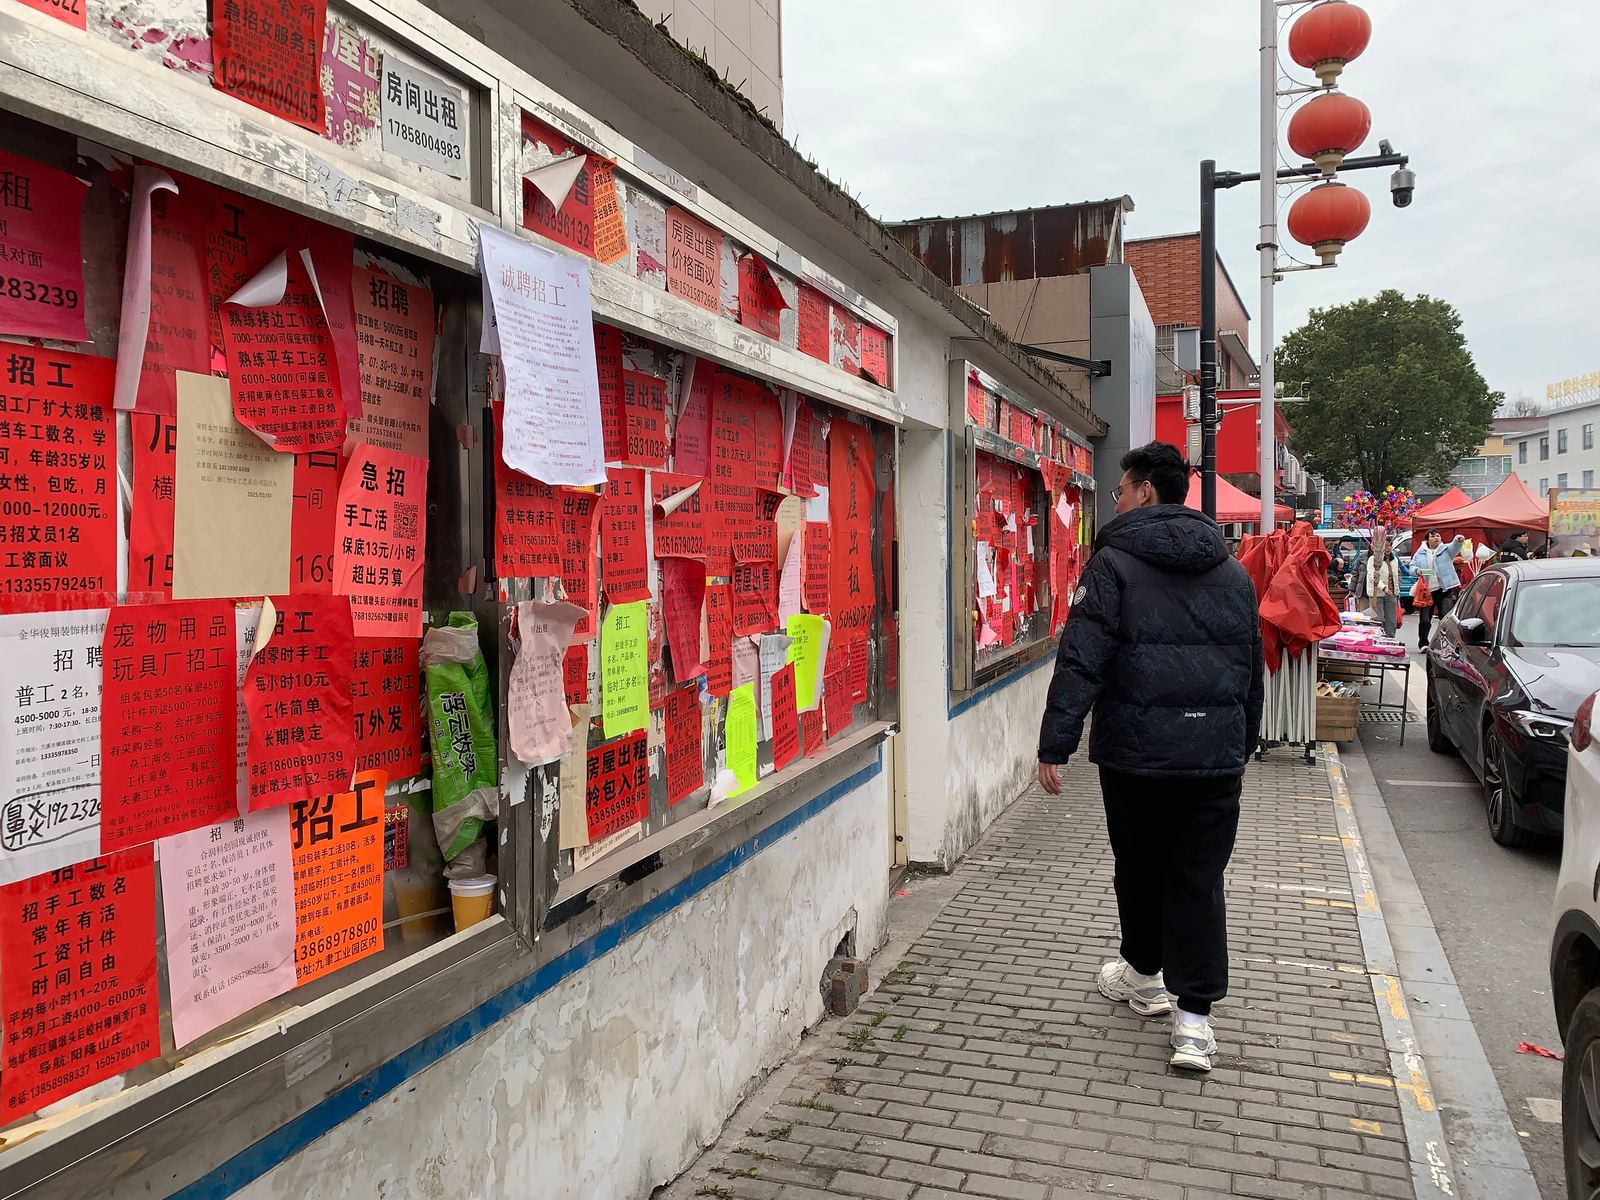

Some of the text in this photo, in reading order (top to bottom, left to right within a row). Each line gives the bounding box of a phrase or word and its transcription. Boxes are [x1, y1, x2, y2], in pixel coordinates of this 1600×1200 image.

[387, 71, 458, 130] 房间出租
[388, 118, 461, 160] 17858004983
[0, 170, 32, 211] 租
[671, 218, 715, 261] 房屋出售
[671, 245, 715, 289] 价格面议
[368, 276, 410, 317] 招聘
[500, 263, 566, 308] 诚聘招工
[7, 354, 74, 389] 招工
[241, 373, 293, 385] 6000-8000
[0, 473, 106, 496] 女性，包吃，月
[360, 460, 406, 498] 急招
[610, 480, 632, 497] 招工
[344, 503, 388, 532] 手工活
[506, 507, 554, 528] 常年有活干
[563, 498, 590, 517] 出租
[5, 550, 69, 569] 工资面议
[342, 535, 416, 562] 保底13元/小时
[352, 564, 404, 588] 超出另算
[113, 615, 228, 649] 宠物用品
[615, 616, 630, 631] 招工
[53, 646, 103, 673] 招聘
[112, 647, 228, 683] 玩具厂招工
[255, 645, 329, 667] 招零时手工
[256, 671, 330, 693] 每小时10元
[265, 697, 321, 720] 工作简单
[265, 723, 323, 748] 长期稳定
[130, 744, 217, 770] 杂工两名 工资面议
[587, 740, 647, 779] 房屋出租
[587, 767, 646, 812] 拎包入住
[291, 781, 379, 850] 招工
[589, 789, 646, 828] 13858999585
[605, 809, 635, 834] 271550
[209, 818, 245, 843] 招聘
[22, 877, 127, 924] 招手工数名
[32, 904, 116, 946] 常年有活
[293, 917, 378, 963] 13868978800
[32, 930, 116, 971] 工资计件
[32, 953, 116, 997] 时间自由
[193, 981, 226, 1003] 联系电话
[8, 975, 119, 1026] 平均每小时11-20元
[8, 984, 146, 1046] 平均月工资4000-6000元
